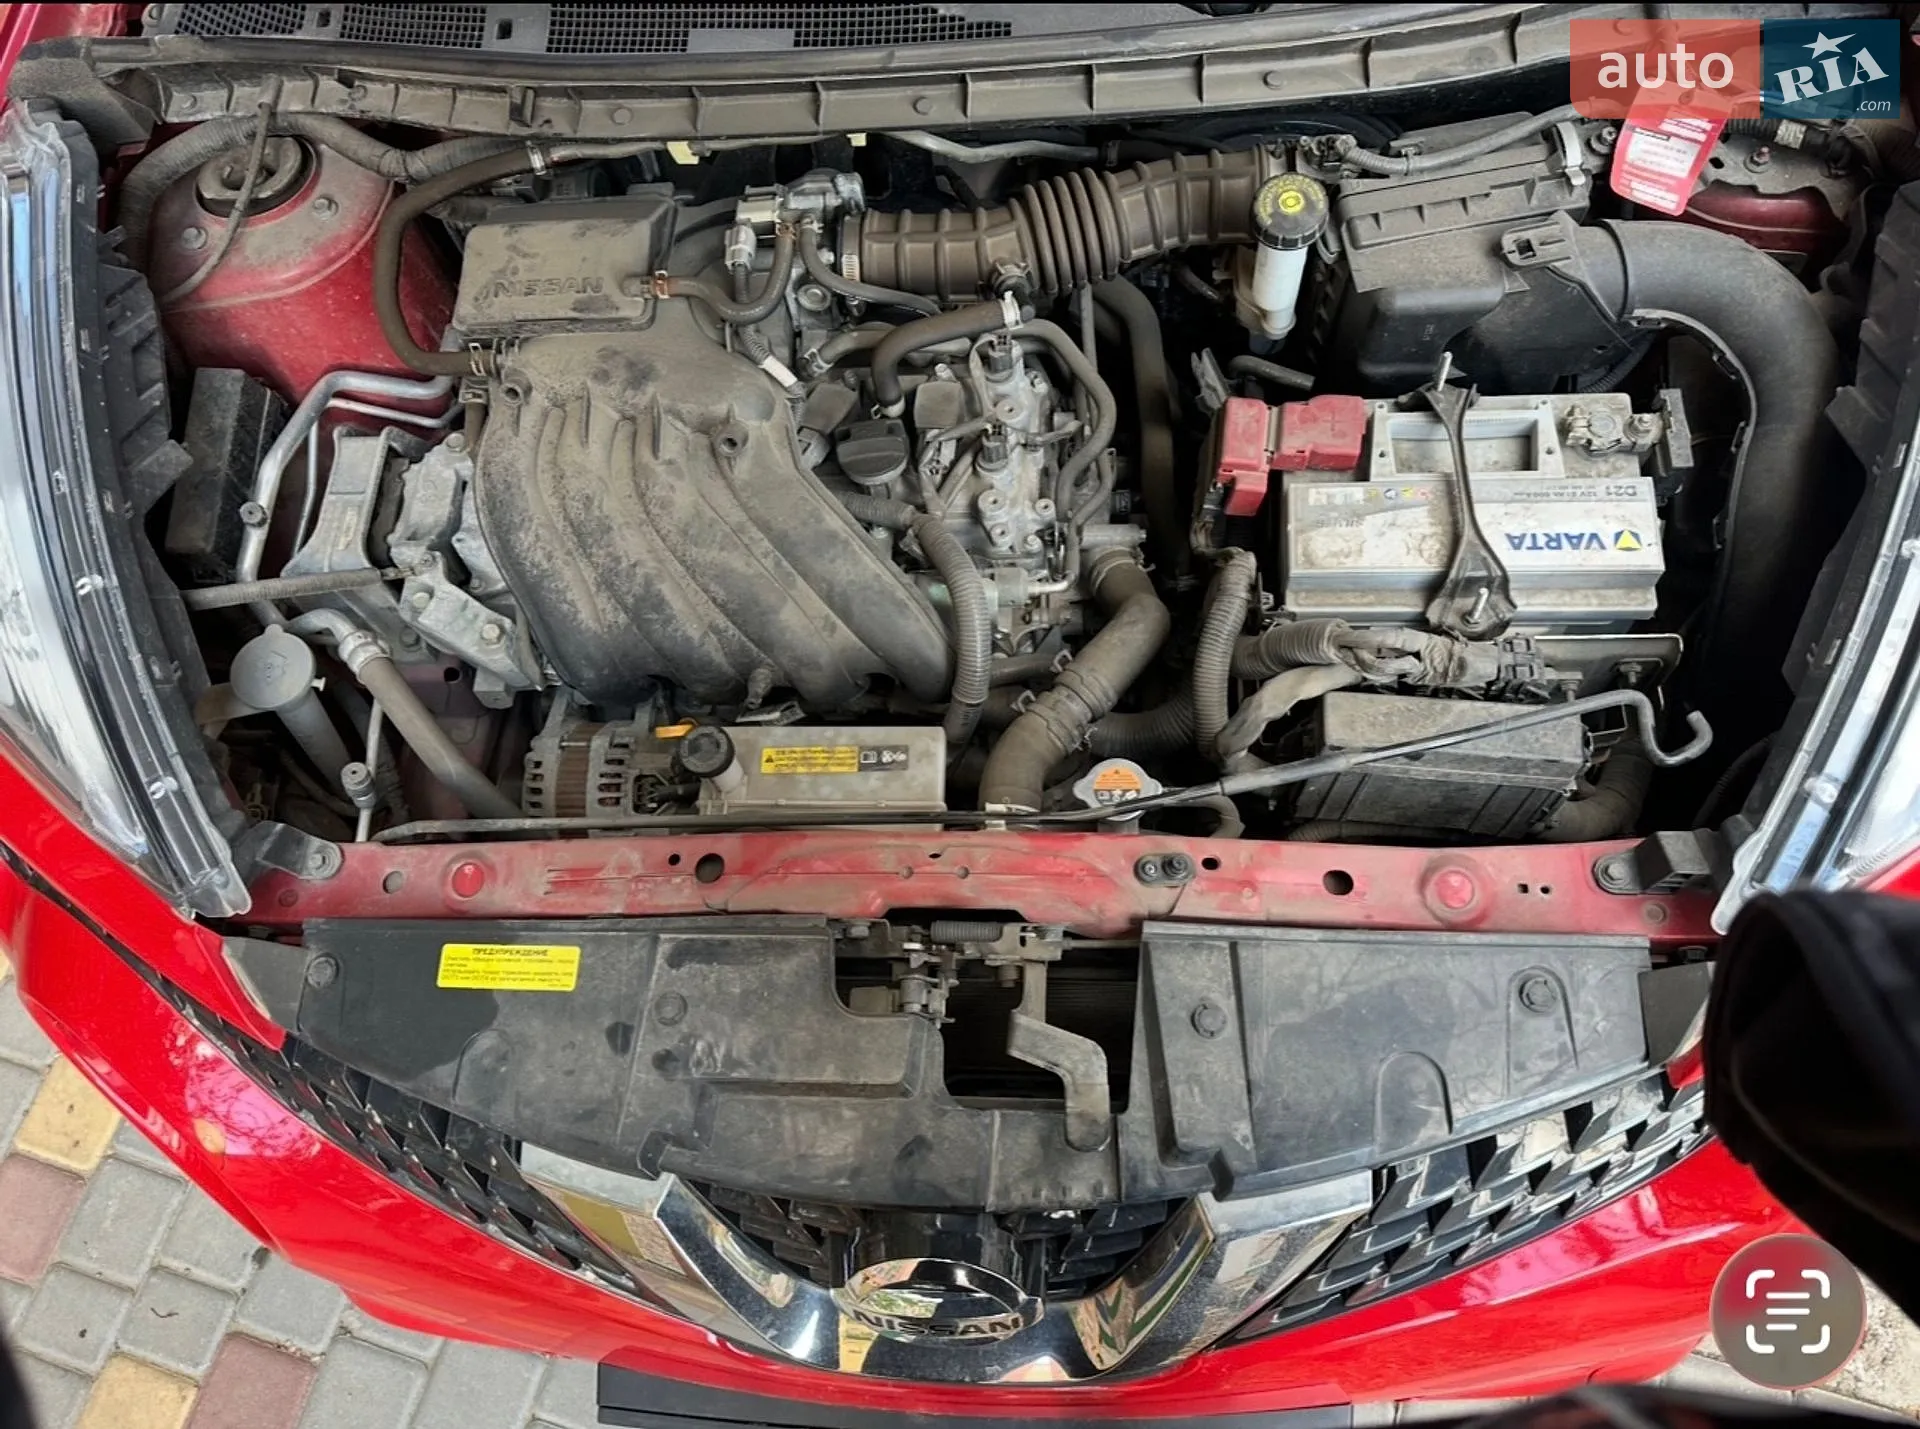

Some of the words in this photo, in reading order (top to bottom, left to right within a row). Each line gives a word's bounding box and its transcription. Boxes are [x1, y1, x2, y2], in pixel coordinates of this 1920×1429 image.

[493, 276, 605, 298] NISSAN
[1605, 485, 1637, 497] D21
[1505, 532, 1606, 550] VARTA
[852, 1309, 1022, 1337] NISSAN
